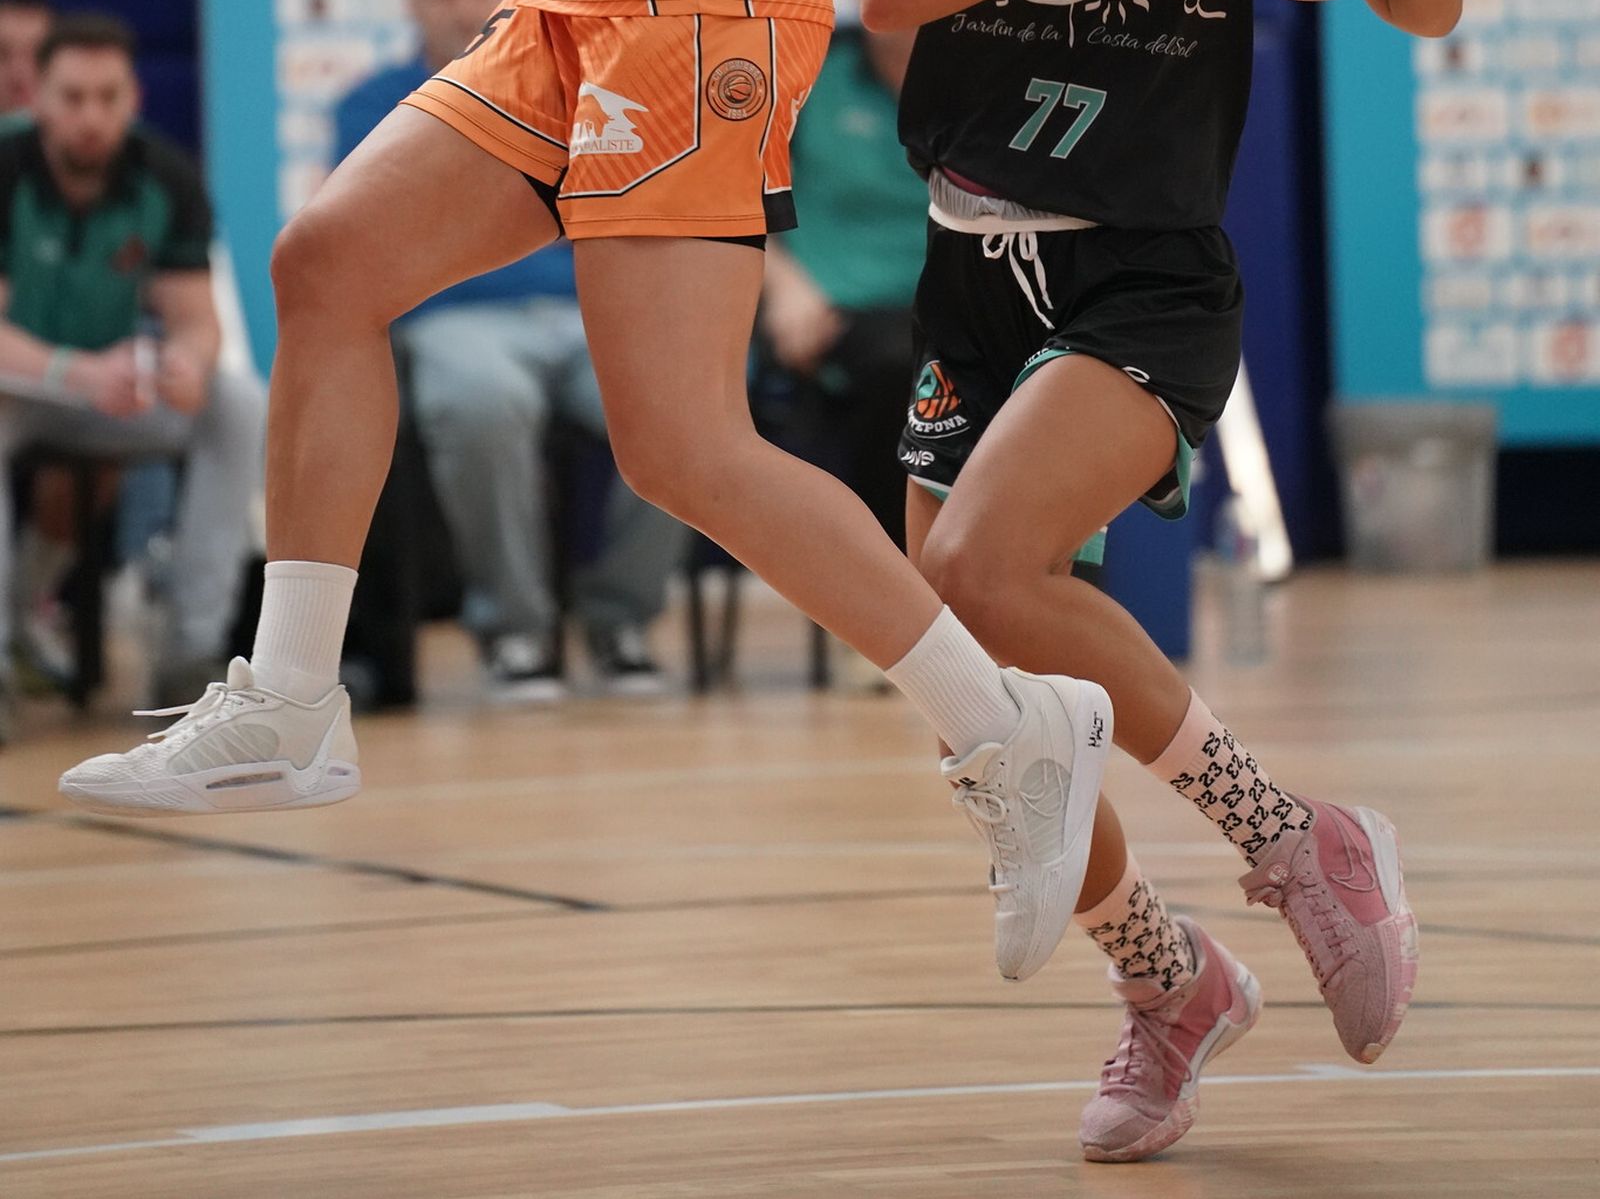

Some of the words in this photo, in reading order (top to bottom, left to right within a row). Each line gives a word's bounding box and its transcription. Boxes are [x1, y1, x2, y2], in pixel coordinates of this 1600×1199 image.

[1017, 22, 1036, 42] de
[1040, 24, 1061, 41] la
[1087, 26, 1139, 48] Costa
[1009, 77, 1107, 160] 77
